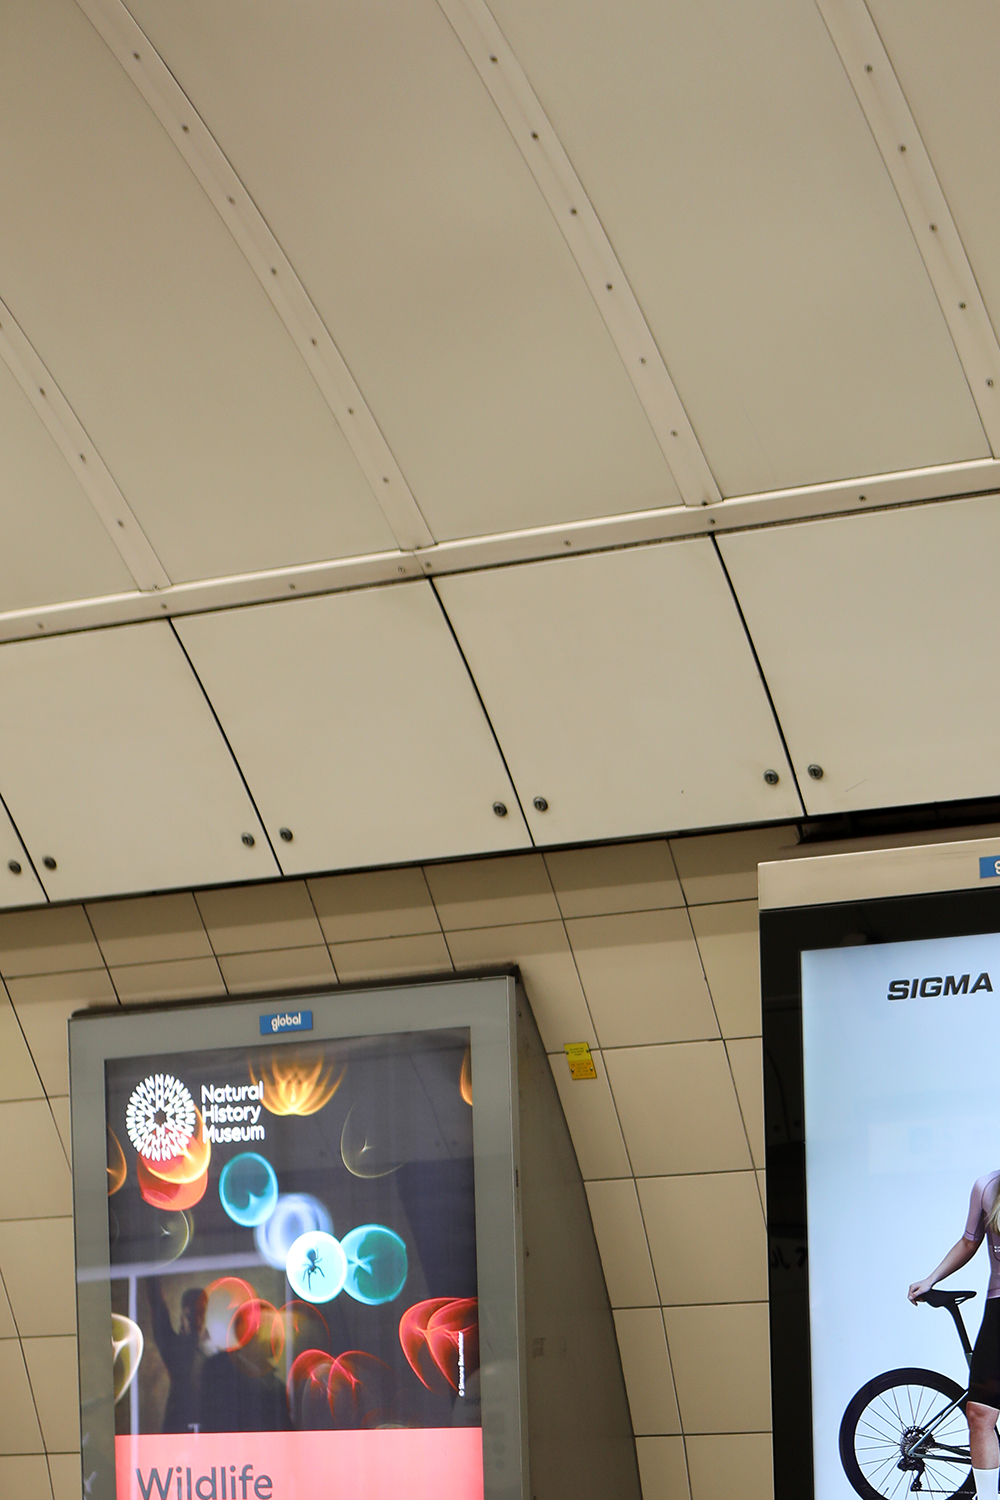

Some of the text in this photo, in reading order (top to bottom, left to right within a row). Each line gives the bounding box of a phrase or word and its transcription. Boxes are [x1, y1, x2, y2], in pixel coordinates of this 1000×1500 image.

[887, 972, 994, 1001] SIGMA
[271, 1012, 302, 1032] global
[201, 1080, 264, 1104] Natural
[202, 1104, 262, 1124] History
[202, 1124, 265, 1144] Museum
[135, 1464, 274, 1500] Wildlife
